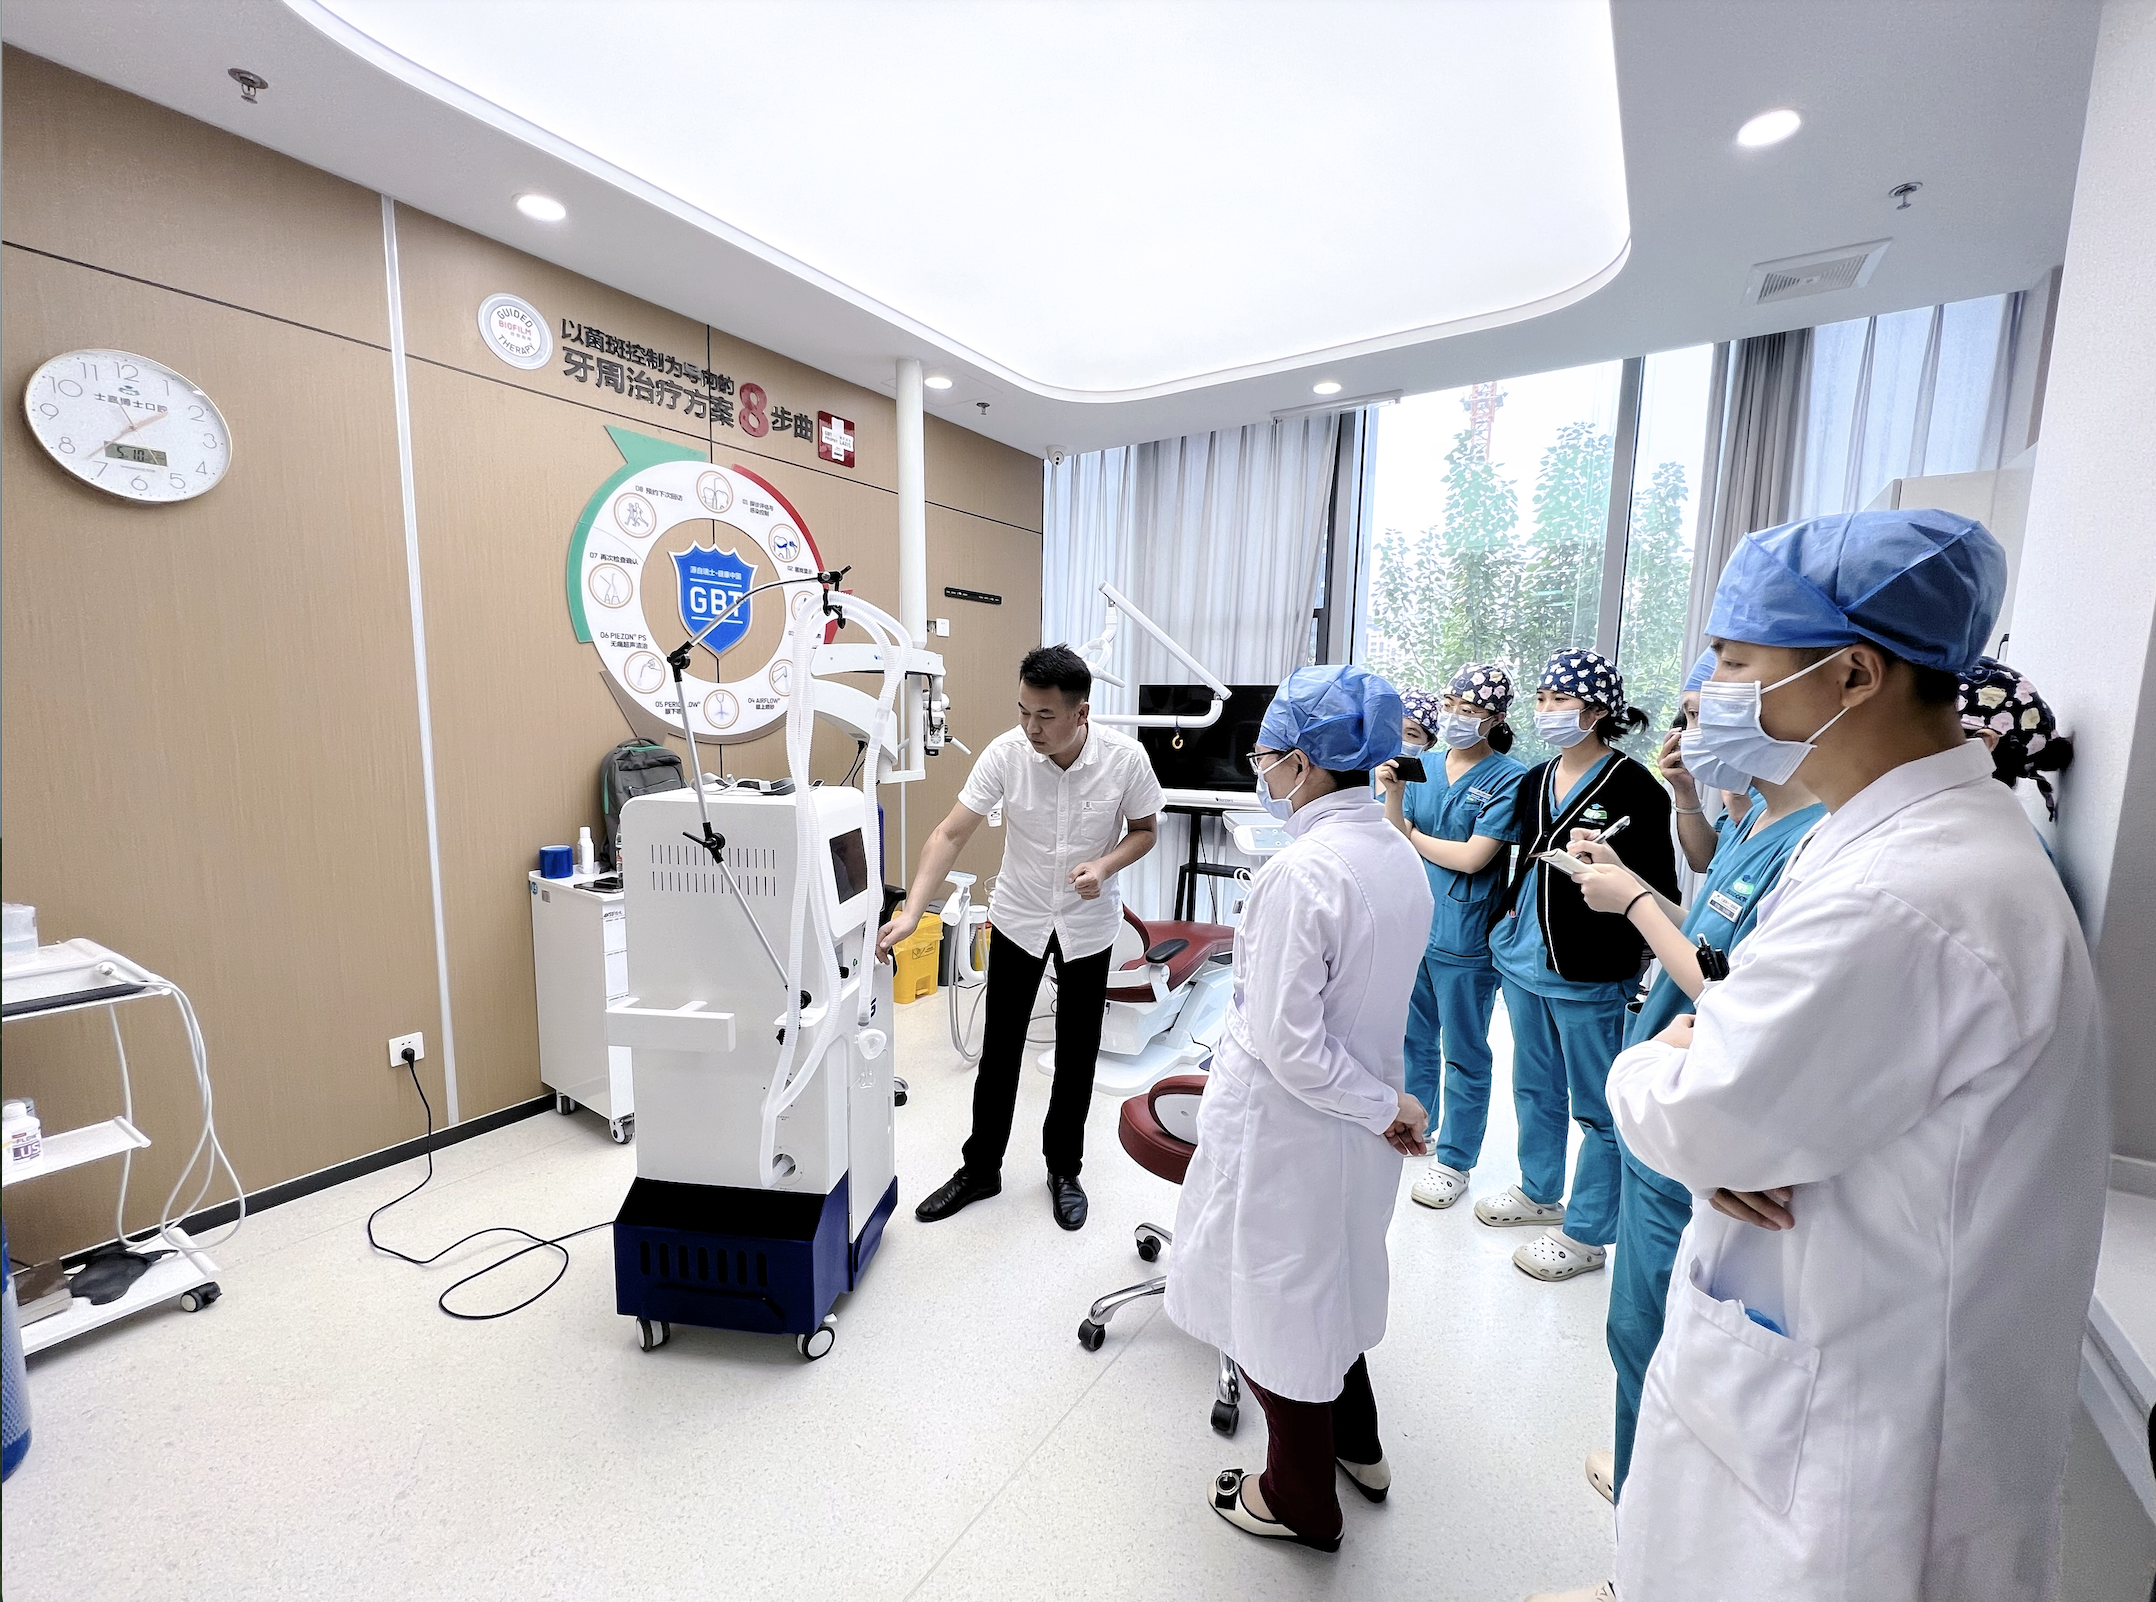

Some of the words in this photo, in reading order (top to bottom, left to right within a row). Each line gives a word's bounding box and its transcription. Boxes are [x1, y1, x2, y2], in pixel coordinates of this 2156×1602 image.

[497, 308, 533, 328] GUIDED
[499, 320, 532, 336] BIOFILM
[498, 334, 535, 355] THERAPY
[561, 318, 735, 395] 以菌斑控制为导向的
[81, 362, 98, 381] 11
[114, 362, 139, 382] 12
[49, 376, 83, 397] 10
[163, 379, 170, 396] 1
[40, 402, 59, 420] 9
[188, 405, 205, 422] 2
[59, 437, 76, 454] 8
[203, 433, 217, 449] 3
[93, 460, 108, 477] 7
[196, 460, 207, 475] 4
[131, 475, 148, 491] 6
[169, 473, 186, 489] 5
[600, 553, 639, 565] 再次检查确认
[690, 586, 744, 617] GBT
[600, 631, 609, 639] 06
